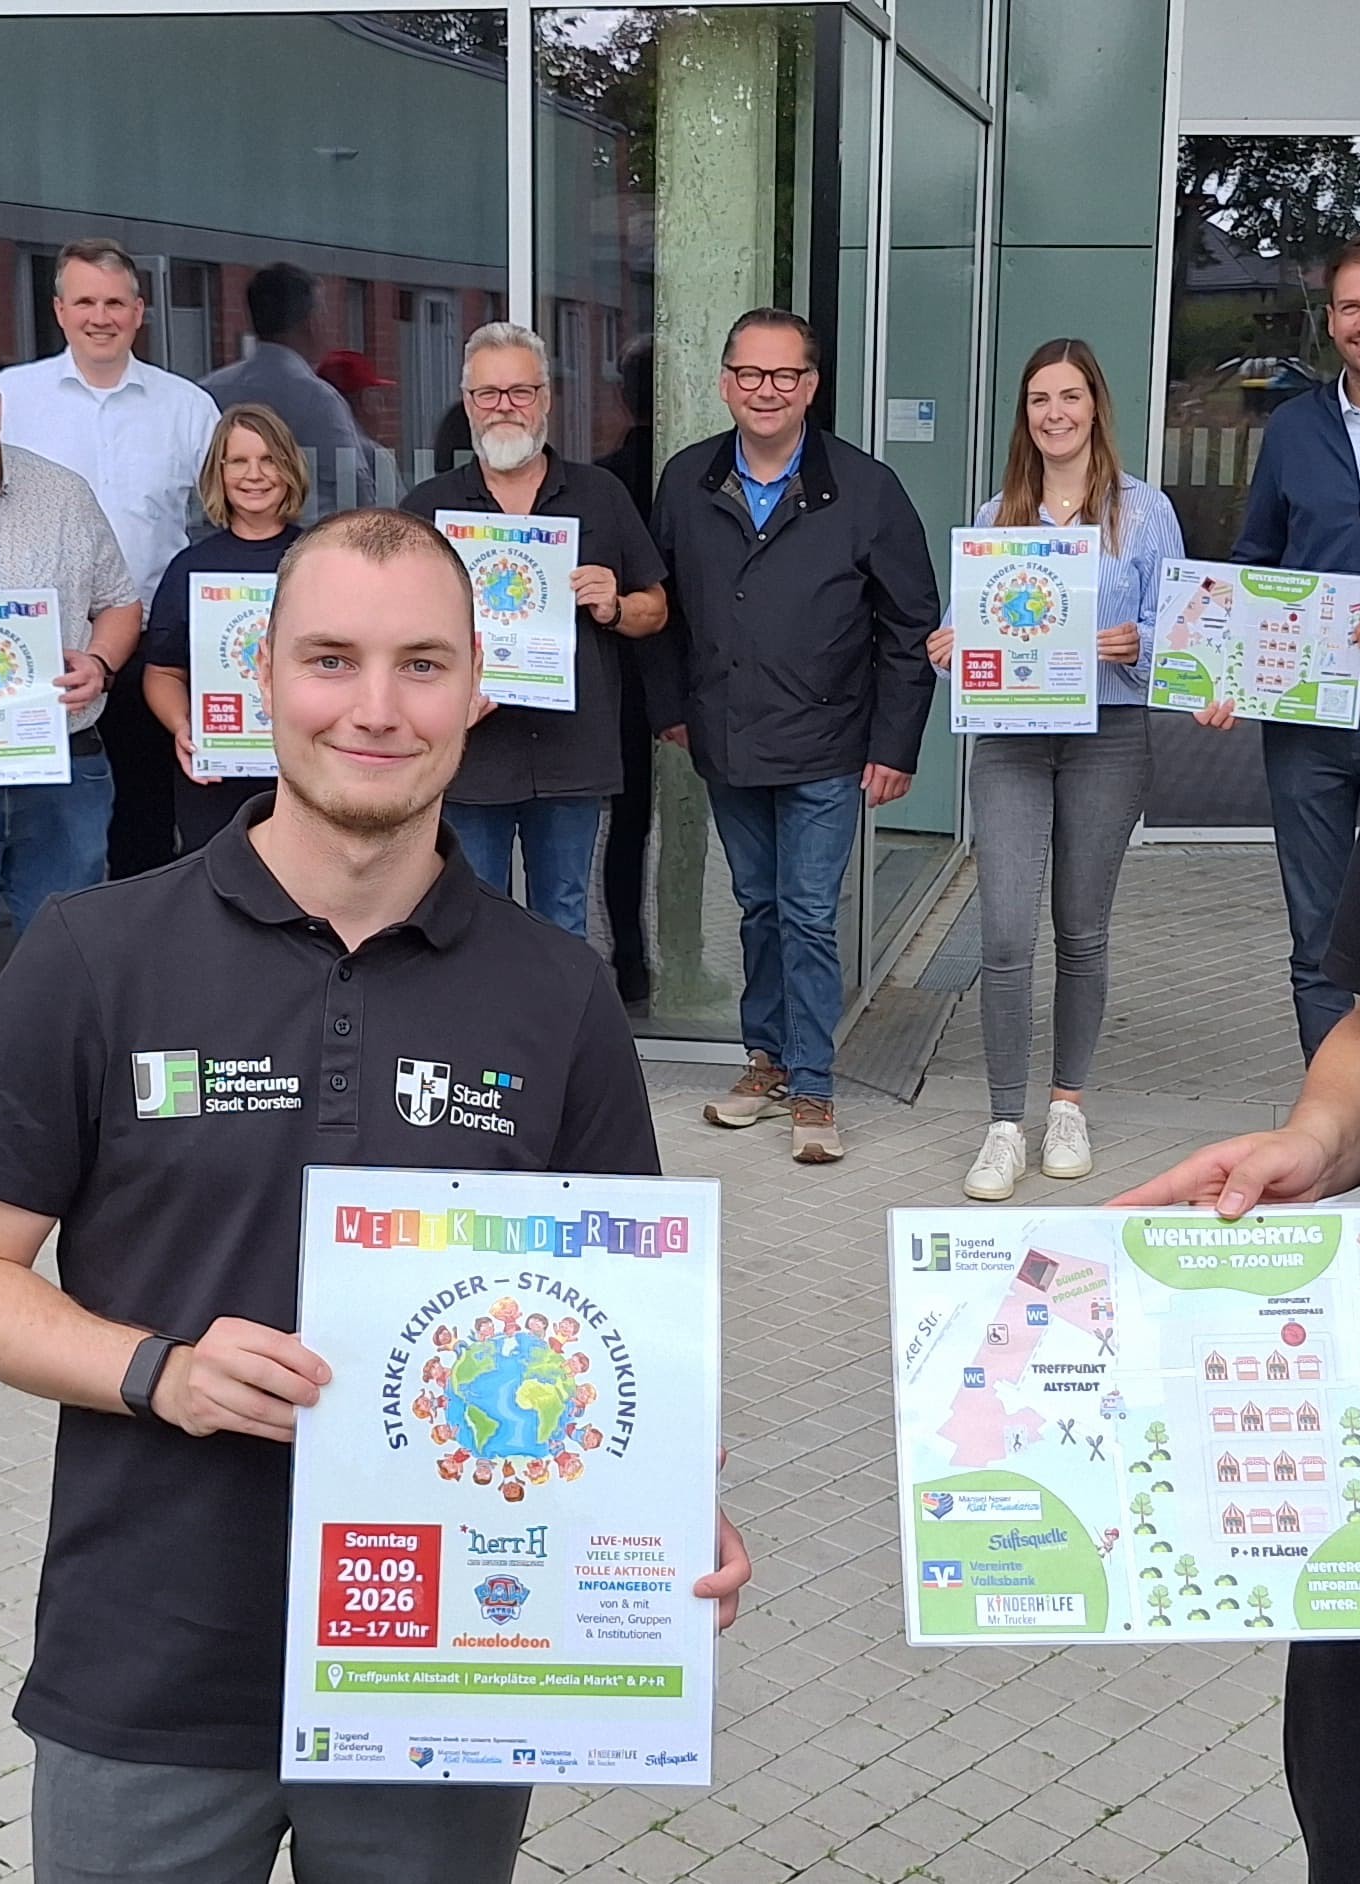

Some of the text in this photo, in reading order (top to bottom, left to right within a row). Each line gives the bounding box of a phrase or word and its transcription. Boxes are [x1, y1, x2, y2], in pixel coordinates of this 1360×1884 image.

[204, 1057, 270, 1075] Jugend
[205, 1076, 298, 1094] Förderung
[453, 1084, 501, 1109] Stadt
[206, 1096, 301, 1112] Stadt Dorsten
[450, 1108, 515, 1135] Dorsten
[340, 1209, 683, 1257] WELTKINDERTAG
[955, 1238, 994, 1247] Jugend
[955, 1250, 1011, 1260] Förderung
[1178, 1255, 1218, 1268] 12.00
[1230, 1255, 1268, 1268] 17.00
[1271, 1254, 1304, 1267] UHR
[955, 1262, 1014, 1271] Stadt Dorsten
[1027, 1310, 1048, 1322] WC
[918, 1311, 942, 1337] Str.
[382, 1347, 410, 1450] STARKE
[400, 1274, 489, 1344] KINDER
[517, 1271, 609, 1330] STARKE
[601, 1328, 637, 1459] ZUKUNFT!
[964, 1372, 985, 1384] WC
[1044, 1382, 1099, 1392] ALTSTADT
[345, 1532, 418, 1551] Sonntag
[590, 1535, 662, 1547] LIVE-MUSIK
[988, 1528, 1068, 1551] Stiftsquelle
[586, 1550, 665, 1562] VIELE SPIELE
[1231, 1548, 1240, 1557] P
[1251, 1547, 1259, 1557] R
[337, 1558, 424, 1583] 20.09.
[574, 1565, 676, 1577] TOLLE AKTIONEN
[969, 1561, 1023, 1571] Vereinte
[578, 1580, 672, 1592] INFOANGEBOTE
[971, 1575, 1036, 1586] Volksbank
[345, 1588, 414, 1612] 2026
[600, 1598, 649, 1609] von & mit
[987, 1595, 1073, 1612] KINDERHILFE
[576, 1613, 672, 1626] Vereinen, Gruppen
[988, 1614, 1036, 1624] Mr Trucker
[394, 1620, 430, 1638] Uhr
[586, 1629, 662, 1640] & Institutionen
[452, 1632, 550, 1648] nickelodeon
[346, 1671, 409, 1685] Treffpunkt
[413, 1672, 460, 1684] Altstadt
[473, 1672, 536, 1687] Parkplätze
[627, 1676, 636, 1686] &
[639, 1676, 665, 1687] P+R
[333, 1731, 369, 1742] Jugend
[333, 1742, 383, 1753] Förderung
[333, 1753, 358, 1762] Stadt
